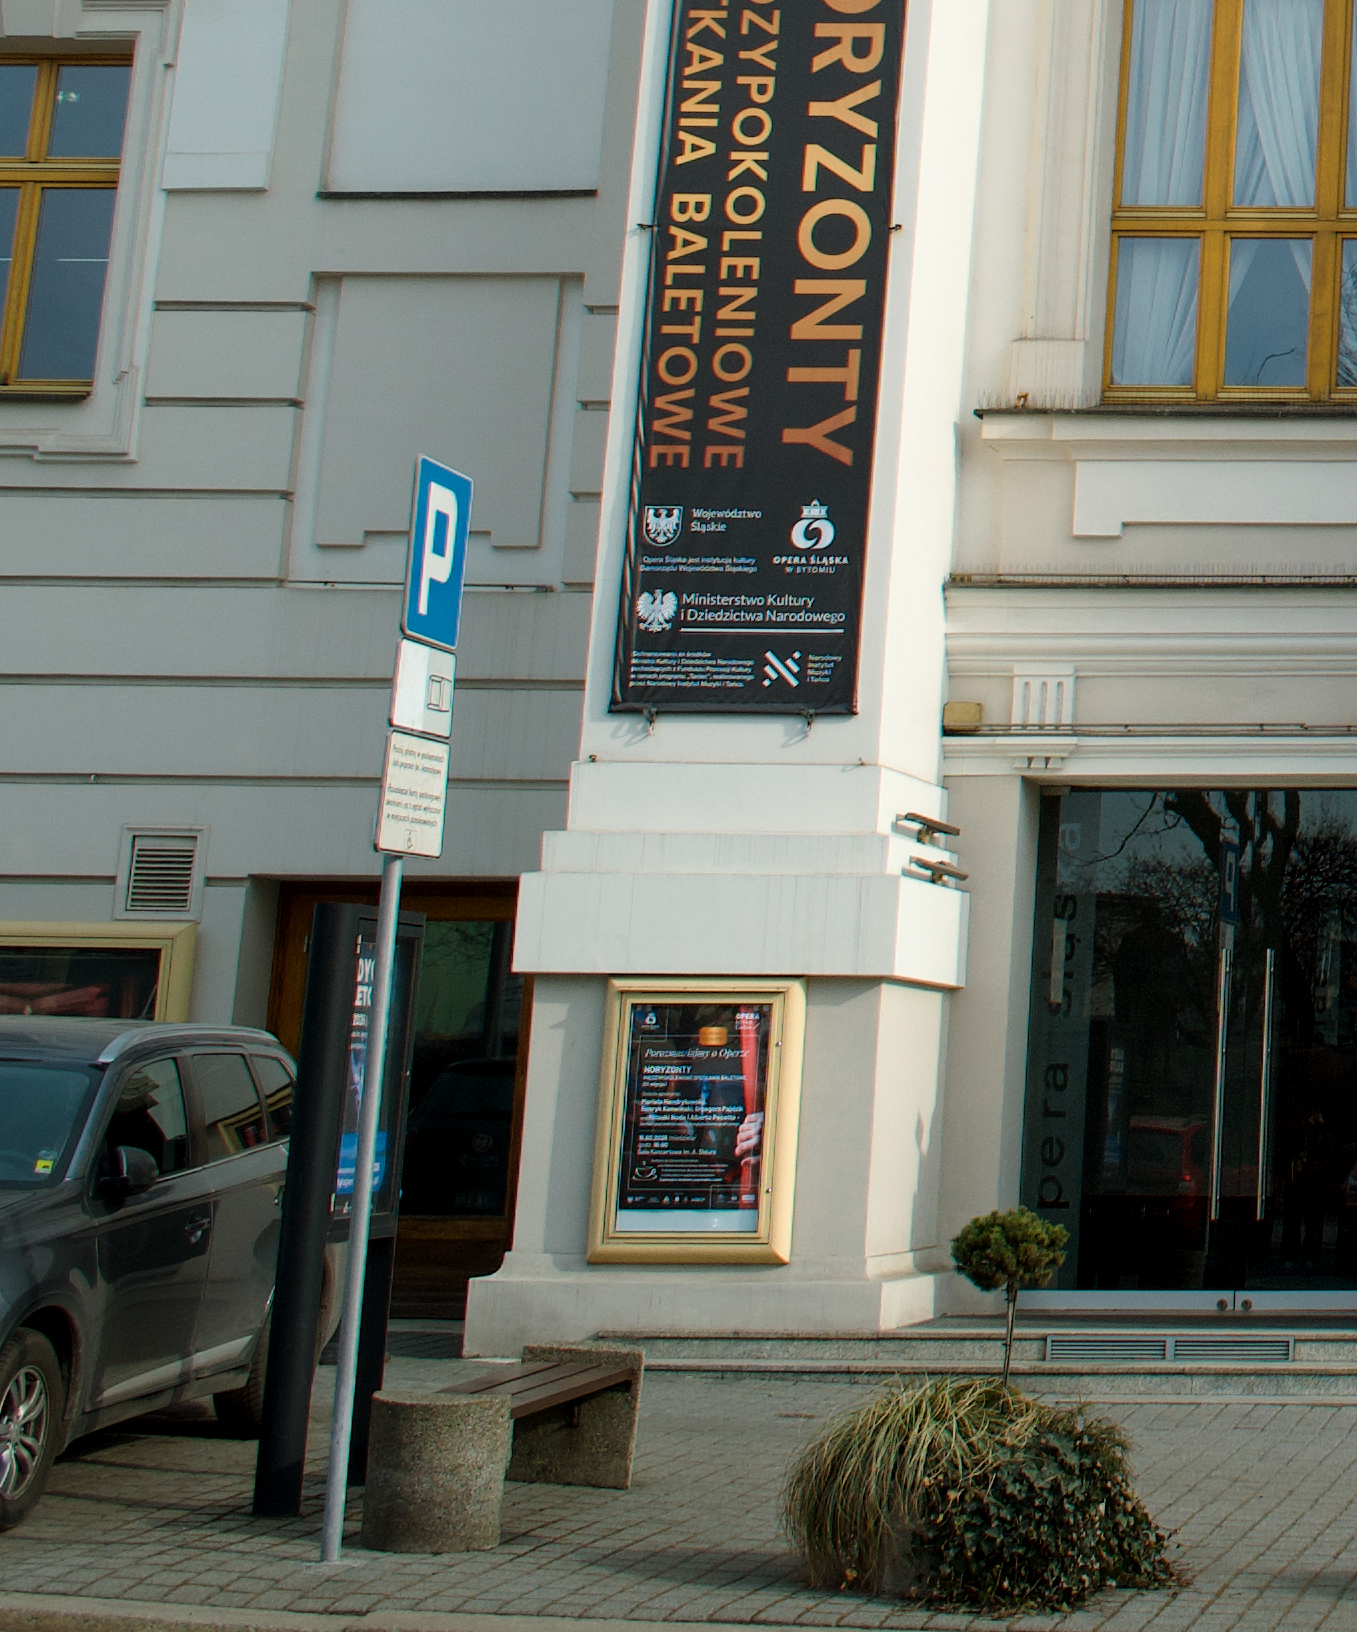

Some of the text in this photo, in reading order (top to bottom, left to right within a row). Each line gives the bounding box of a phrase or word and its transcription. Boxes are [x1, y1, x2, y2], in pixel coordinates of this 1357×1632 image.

[650, 192, 712, 469] BALETOWE
[417, 480, 459, 616] P
[772, 555, 808, 565] OPERA
[681, 592, 815, 608] Ministerstwo Kultury
[687, 608, 764, 622] Dziedzictwa
[765, 609, 846, 625] Narodowego
[1035, 1062, 1072, 1211] pera
